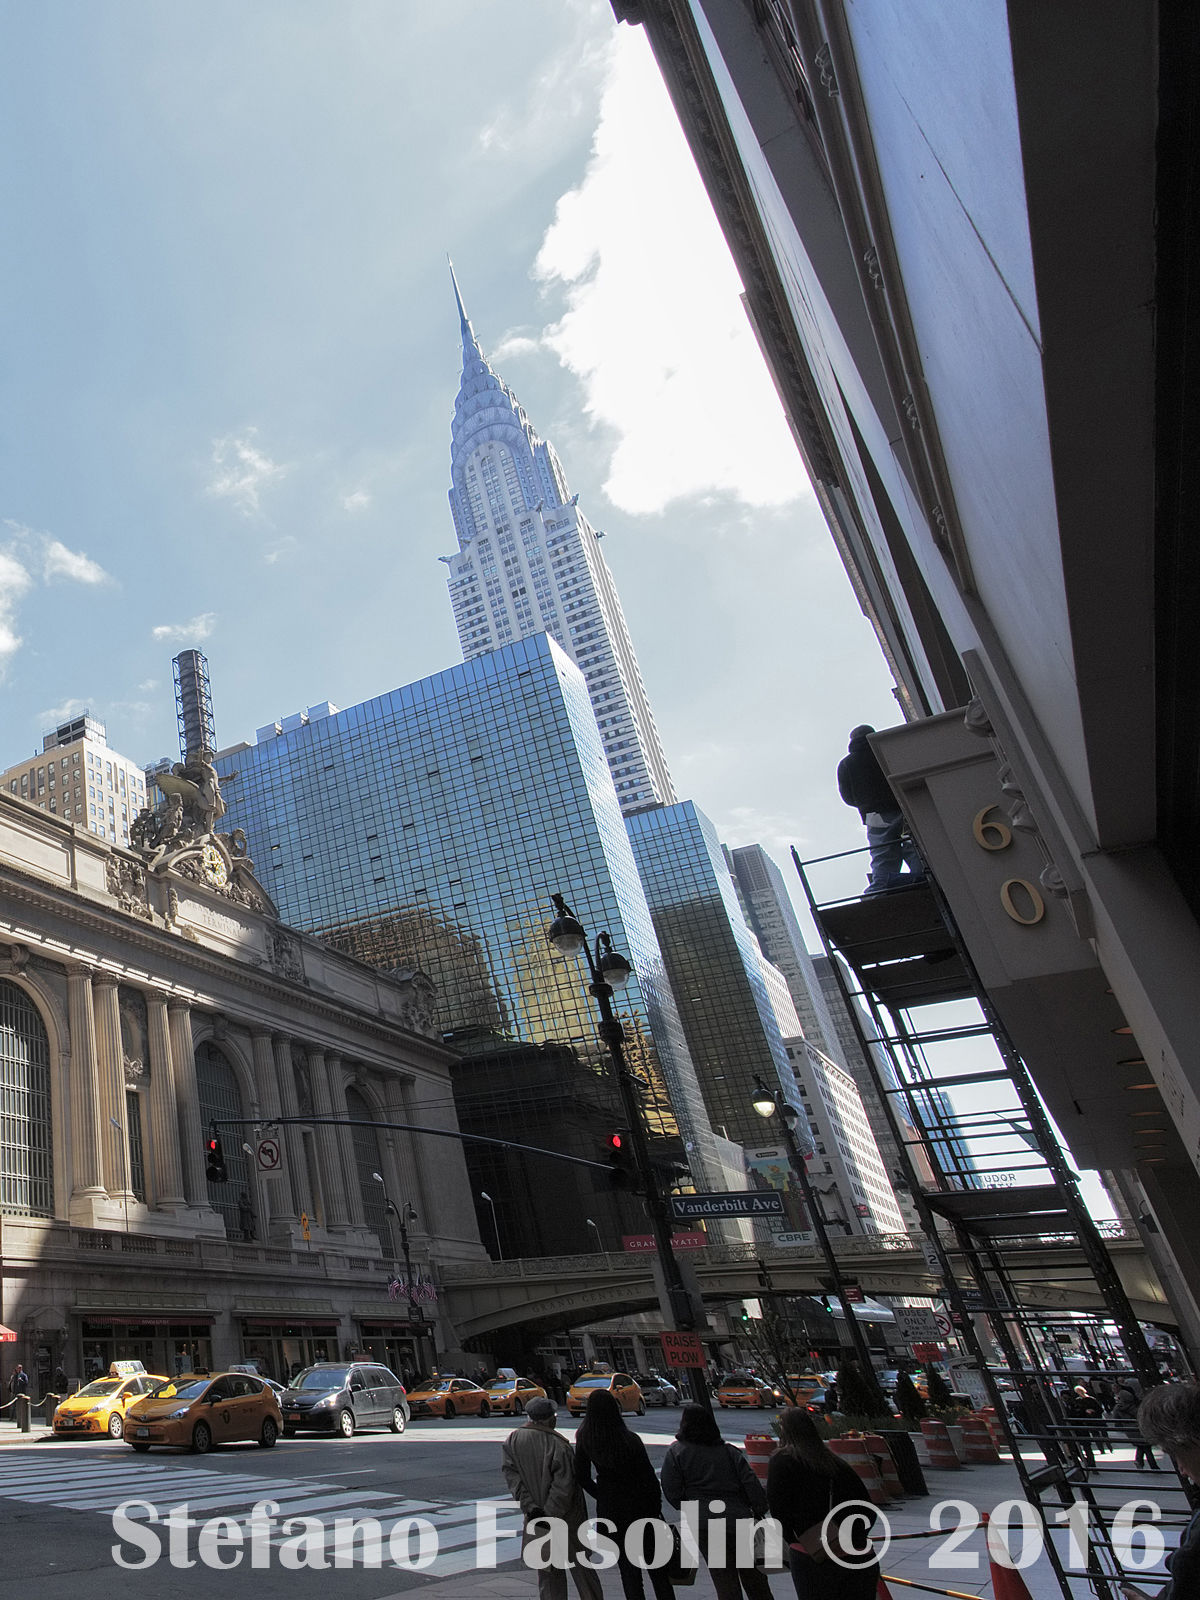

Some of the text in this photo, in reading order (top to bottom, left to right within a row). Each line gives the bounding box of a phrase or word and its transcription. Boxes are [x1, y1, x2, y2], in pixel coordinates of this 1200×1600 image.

[977, 1173, 1017, 1183] TUDOR
[674, 1198, 781, 1214] Vanderbilt Ave
[778, 1233, 811, 1242] CBRE
[629, 1240, 656, 1248] GRAN
[897, 1309, 928, 1317] BUSES
[665, 1335, 697, 1348] RAISE
[669, 1350, 699, 1363] PLOW
